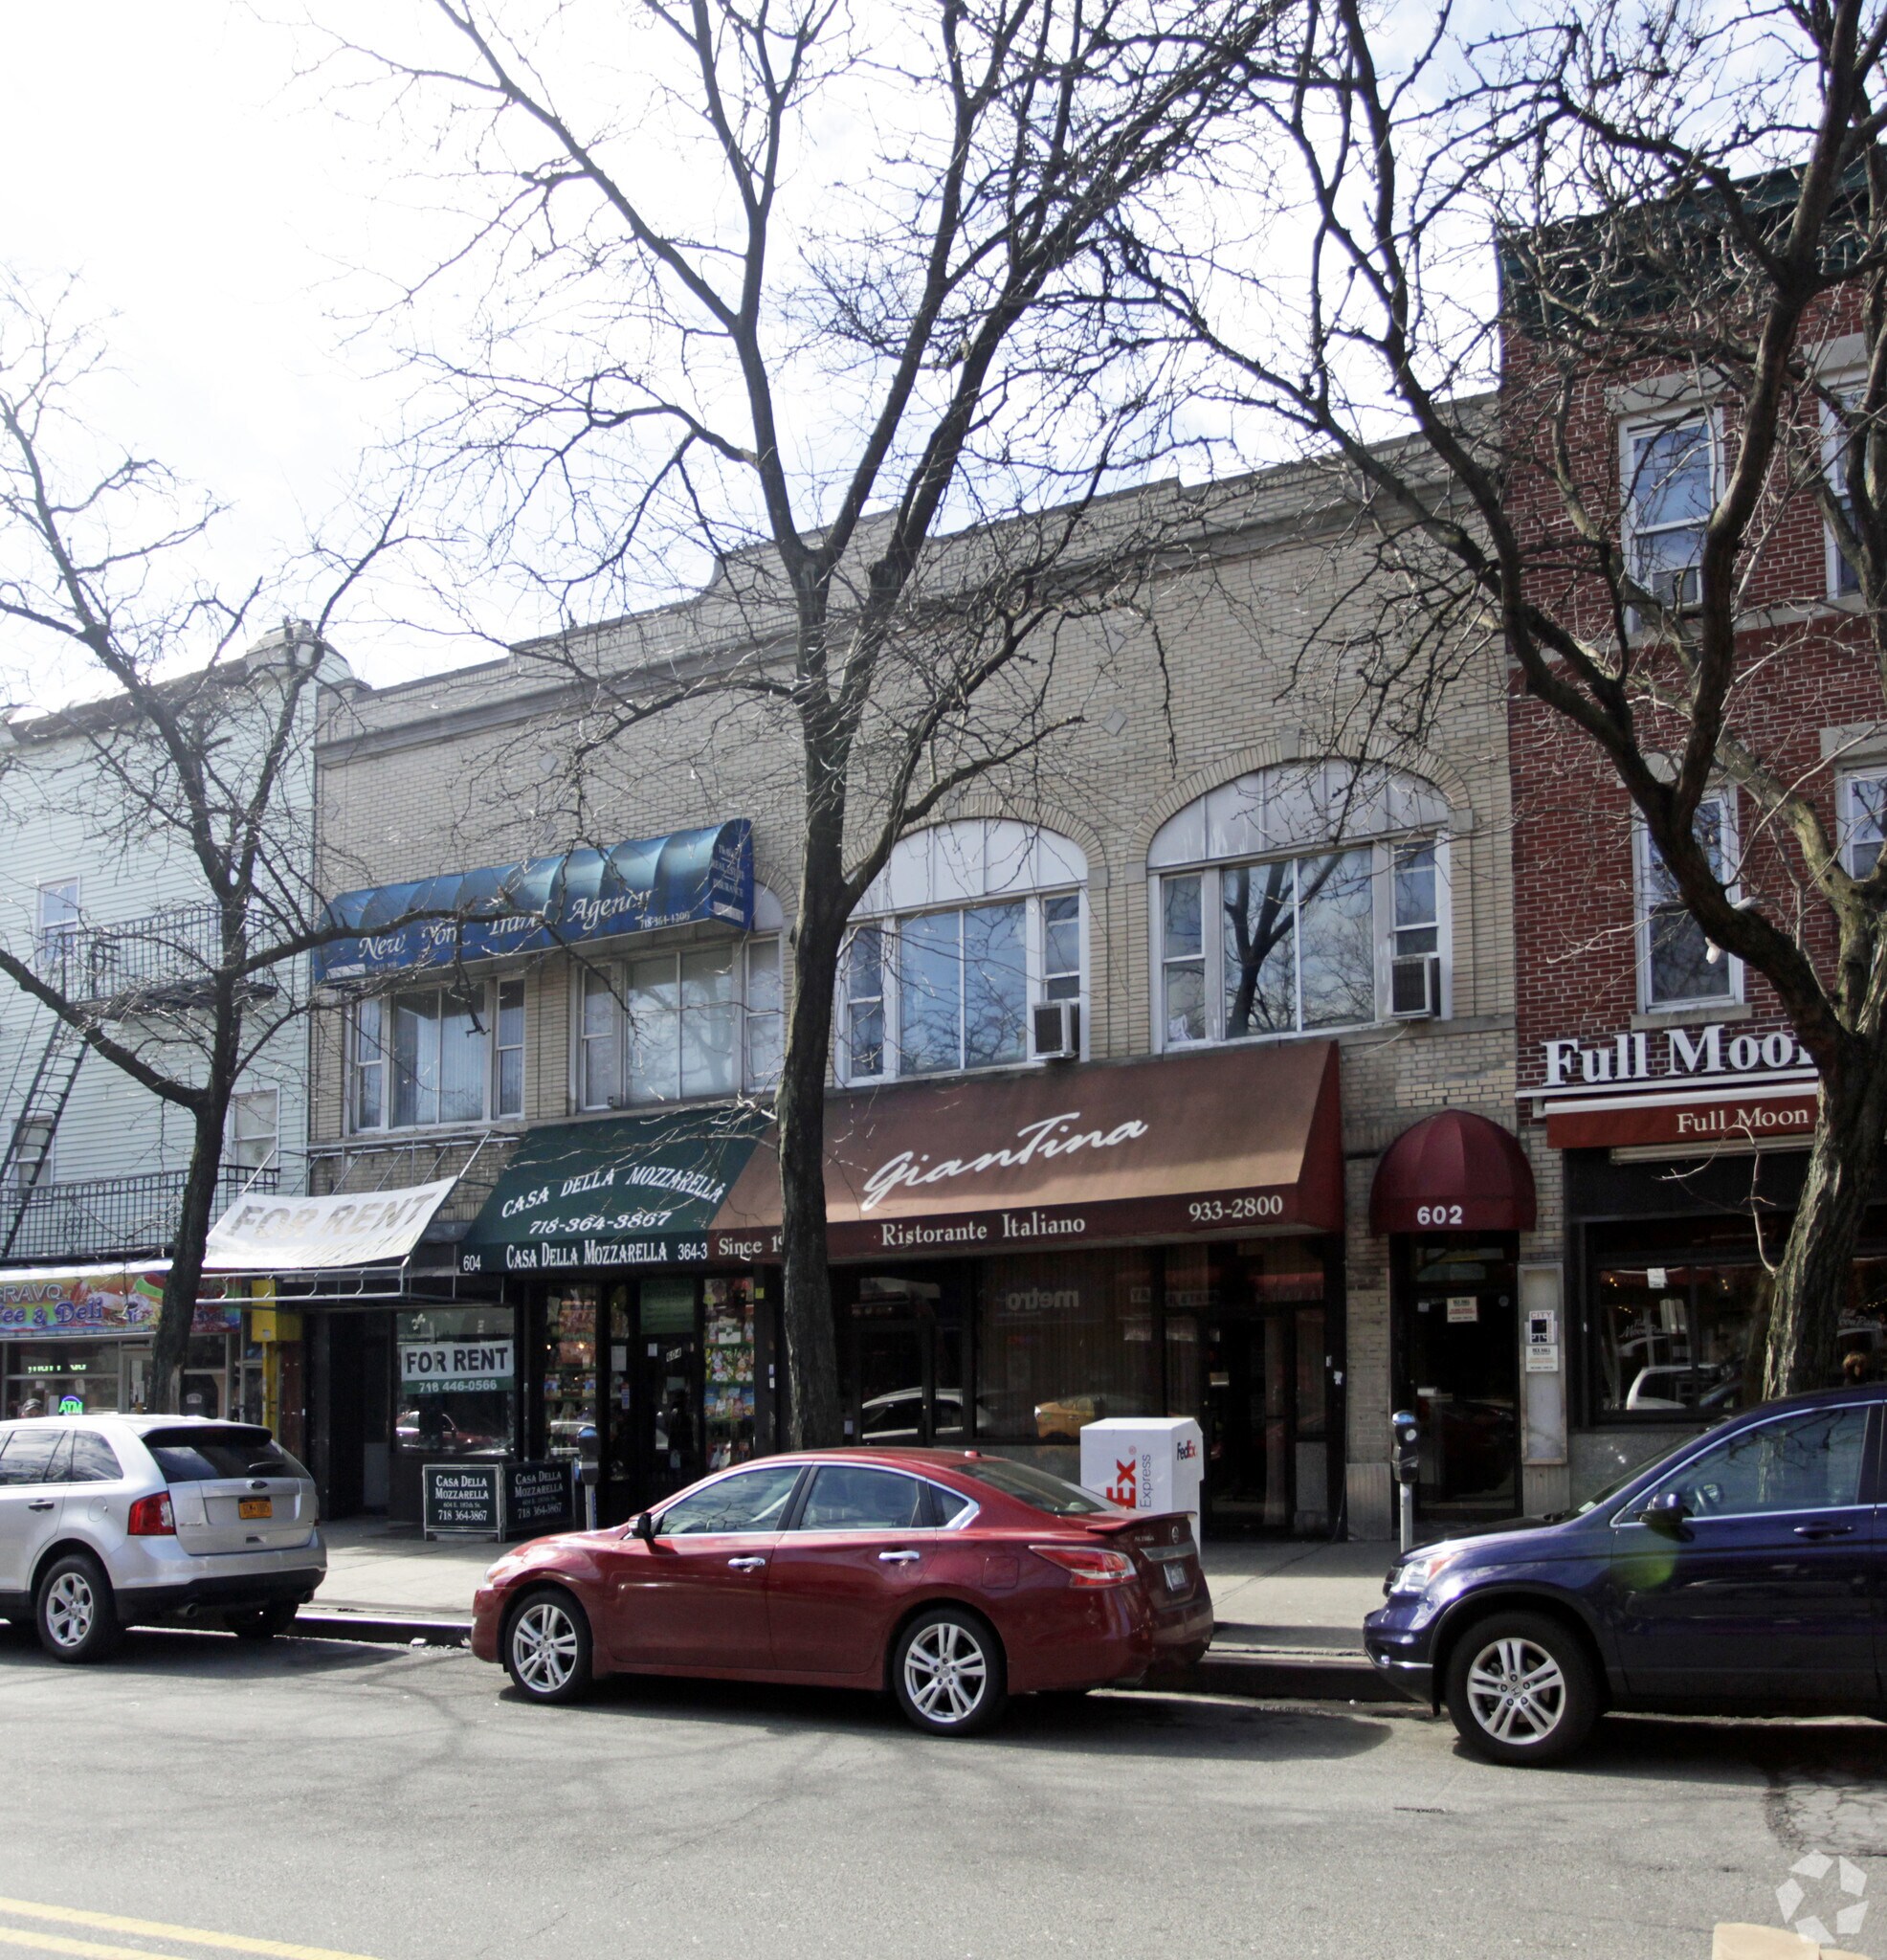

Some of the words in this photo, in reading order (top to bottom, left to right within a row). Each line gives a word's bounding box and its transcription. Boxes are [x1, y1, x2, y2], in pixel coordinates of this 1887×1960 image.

[359, 935, 406, 960] New
[566, 889, 653, 931] Agency
[1542, 1033, 1651, 1086] Full
[1676, 1110, 1726, 1133] Full
[1735, 1106, 1809, 1128] Moon
[500, 1187, 549, 1218] CASA
[560, 1168, 615, 1197] DELLA
[625, 1166, 726, 1204] MOZZARELLA
[226, 1205, 320, 1240] FOR
[320, 1192, 438, 1236] RENT
[1188, 1195, 1283, 1222] 933-2800
[1416, 1205, 1463, 1226] 602
[529, 1211, 672, 1235] 718-364-3867
[880, 1220, 988, 1247] Ristorante
[1002, 1211, 1086, 1238] Italiano
[506, 1245, 537, 1270] CASA
[542, 1242, 579, 1267] DELLA
[584, 1239, 668, 1265] MOZZARELLA
[719, 1237, 763, 1256] Since
[463, 1255, 481, 1272] 604
[0, 1283, 63, 1303] RAVO
[33, 1306, 47, 1326] &
[55, 1296, 103, 1325] Deli
[406, 1351, 447, 1374] FOR
[454, 1347, 508, 1371] RENT
[419, 1382, 439, 1392] 718
[442, 1380, 498, 1392] 446-0566
[58, 1400, 83, 1414] ATM
[1177, 1439, 1197, 1461] FedEx
[435, 1475, 459, 1487] CASA
[461, 1476, 487, 1487] DELLA
[514, 1482, 564, 1499] MOZZARELLA
[515, 1473, 537, 1485] CASA
[1140, 1454, 1153, 1508] Express
[434, 1488, 489, 1500] MOZZARELLA
[438, 1509, 453, 1521] 718
[455, 1509, 488, 1522] 364-3867
